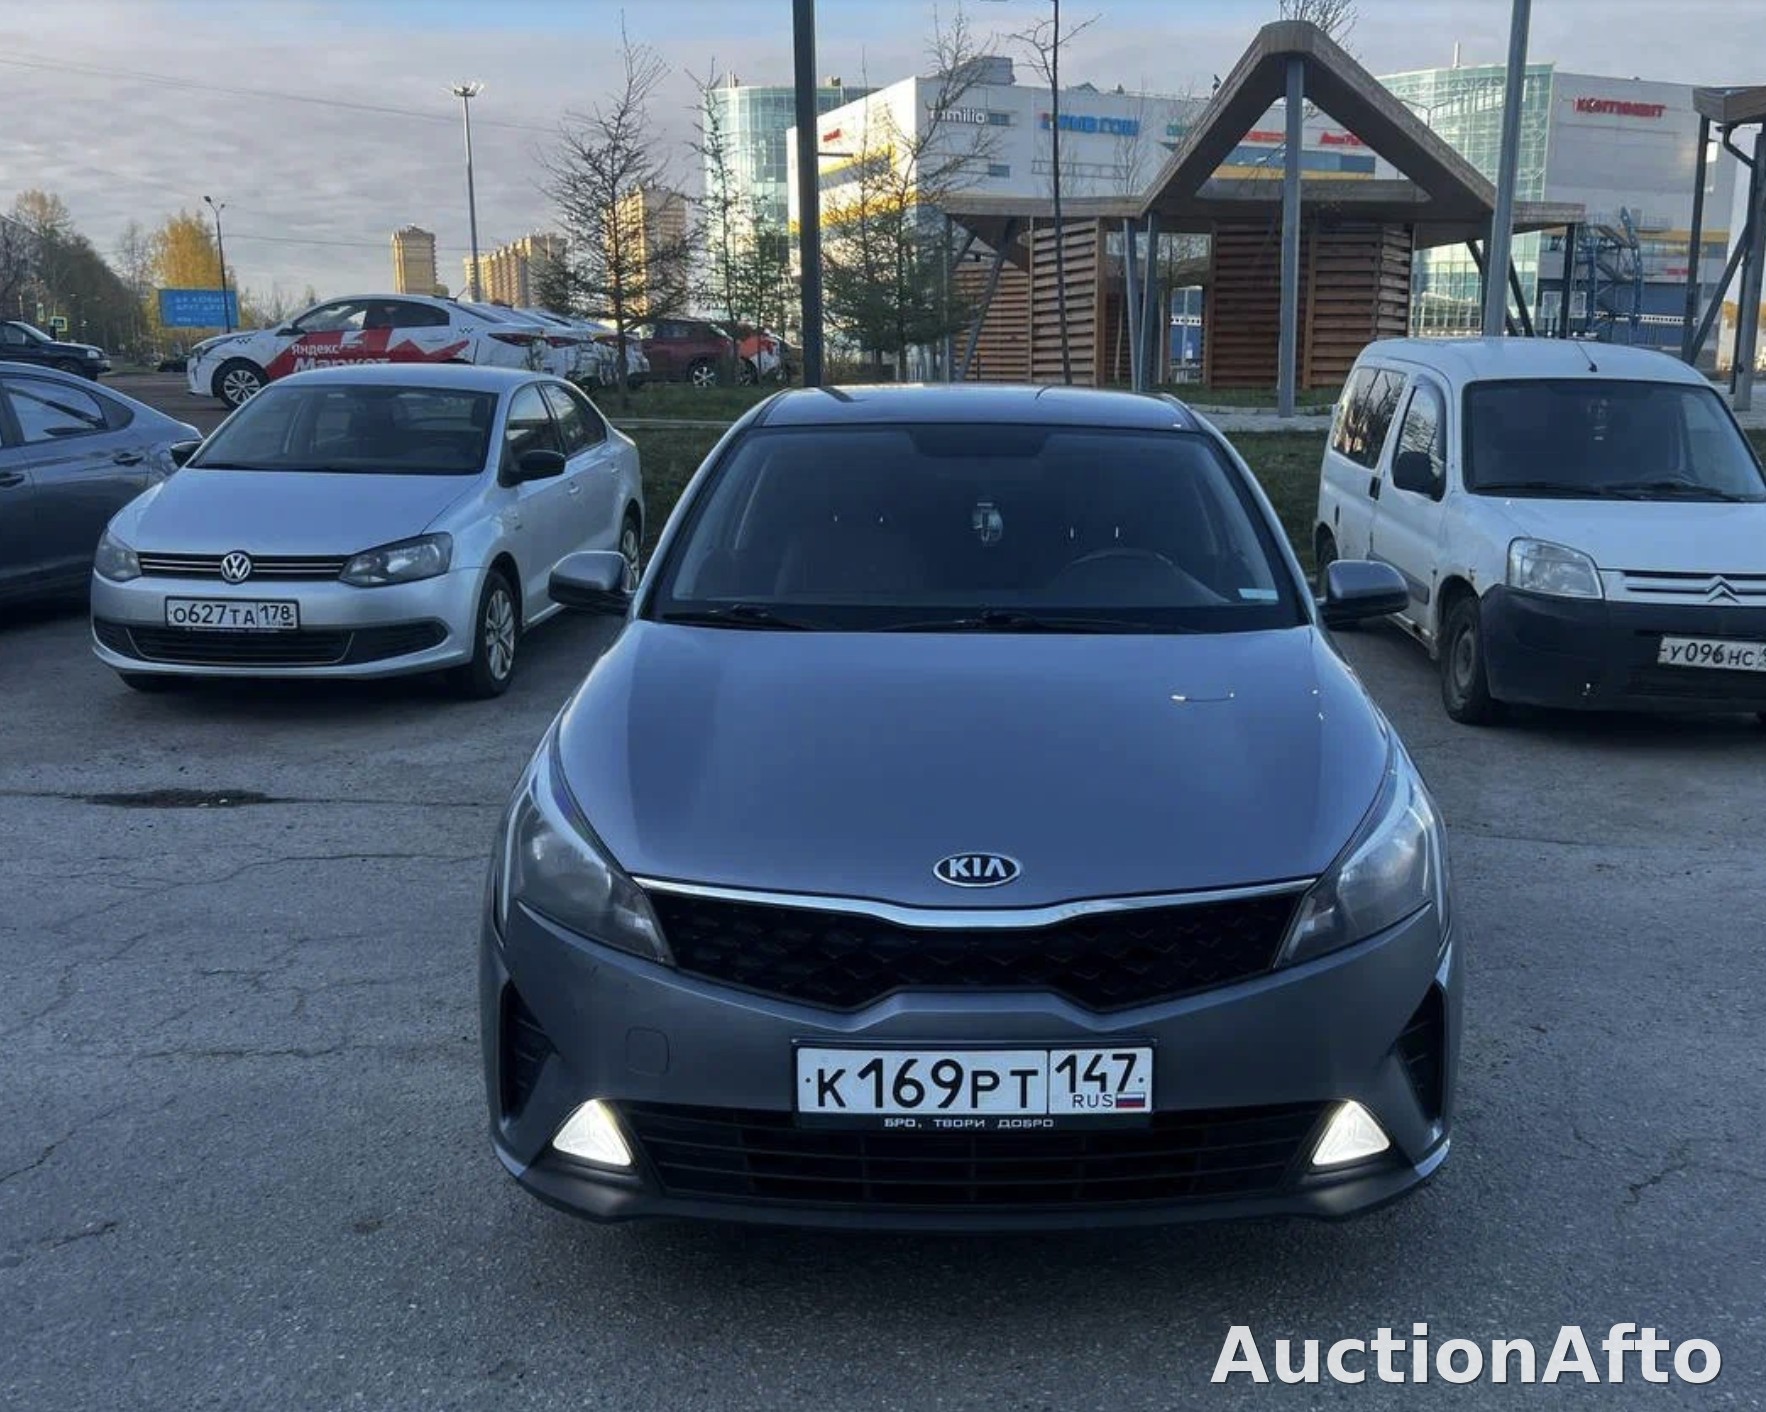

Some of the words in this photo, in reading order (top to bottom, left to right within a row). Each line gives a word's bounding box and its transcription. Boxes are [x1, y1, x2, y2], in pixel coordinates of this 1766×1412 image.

[292, 344, 340, 356] Яндекс
[173, 603, 256, 625] О627ТА
[260, 604, 290, 620] 178
[1670, 643, 1755, 666] У096НС
[949, 857, 1007, 878] KIA
[817, 1058, 1039, 1108] К169РТ
[1055, 1053, 1137, 1093] 147
[1072, 1094, 1114, 1108] RUS
[933, 1119, 985, 1128] ТВОРИ
[997, 1119, 1054, 1129] ДОБРО
